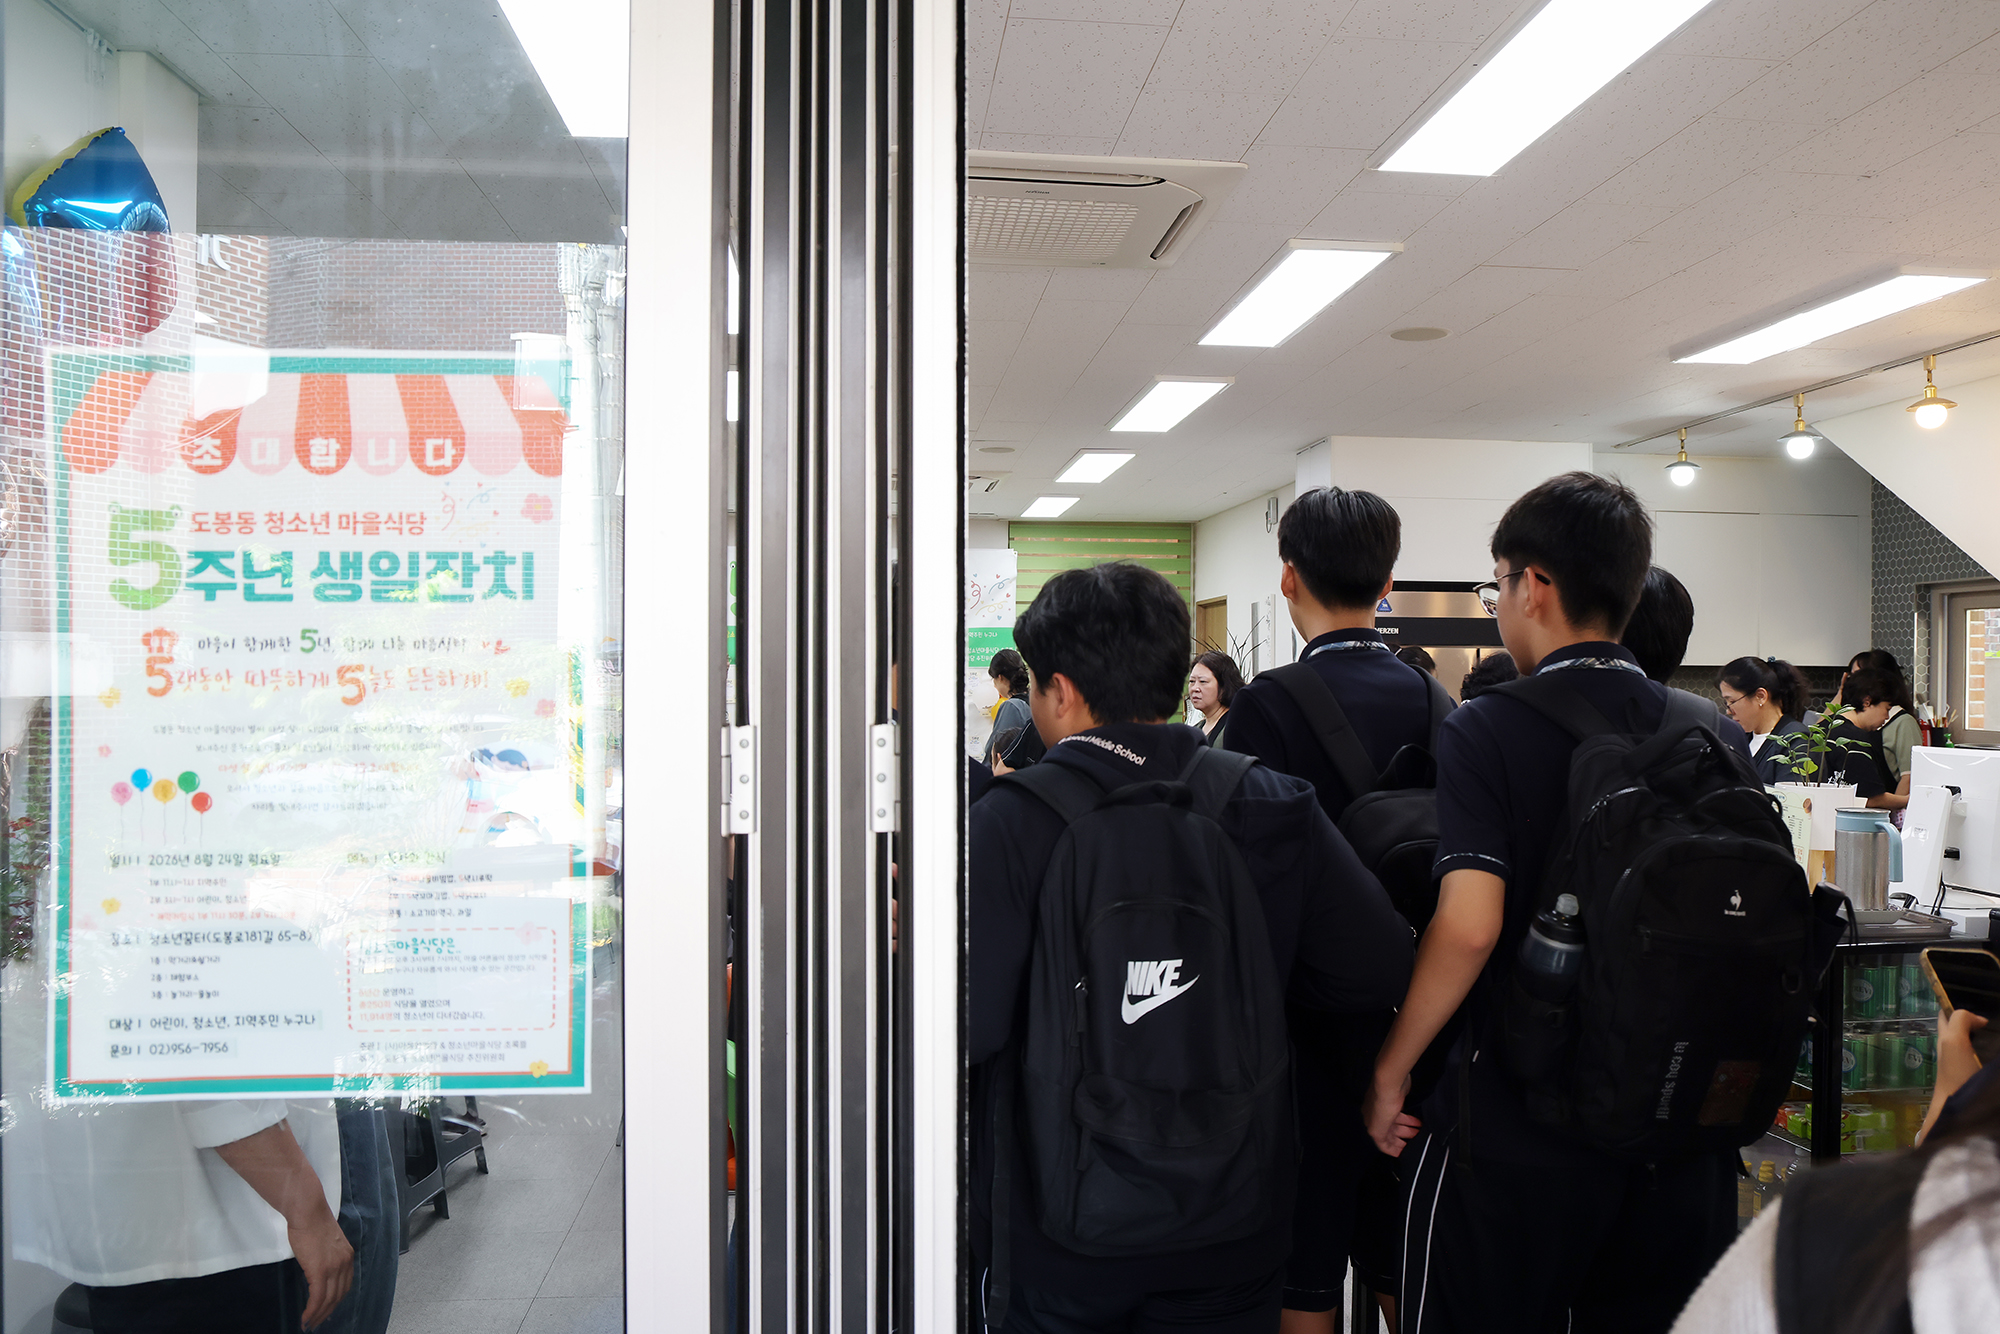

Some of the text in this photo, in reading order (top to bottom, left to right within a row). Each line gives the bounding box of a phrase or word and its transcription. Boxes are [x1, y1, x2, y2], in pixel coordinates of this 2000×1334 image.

[191, 437, 458, 468] 초대합니다
[190, 511, 427, 536] 도봉동 청소년 마을식당
[309, 549, 534, 603] 생일잔치
[197, 635, 236, 652] 마을이
[243, 635, 292, 652] 함께한
[244, 666, 329, 692] 따뜻하게
[1089, 735, 1115, 751] Middle
[1114, 743, 1147, 766] School
[148, 854, 190, 868] 2026년
[193, 854, 213, 868] 8월
[217, 854, 243, 868] 24일
[247, 853, 281, 868] 월요일
[277, 929, 314, 944] 65-8)
[1127, 959, 1183, 996] NIKE
[382, 986, 414, 997] 운영하고
[393, 999, 417, 1009] 식당을
[419, 999, 451, 1009] 열었으며
[108, 1013, 316, 1031] 대상 어린이, 청소년, 지역주민 누구나
[402, 1012, 434, 1022] 청소년이
[436, 1011, 486, 1022] 다녀갔습니다.
[110, 1042, 230, 1059] 문의 02)956-7956
[447, 1041, 503, 1050] 청소년마을식당
